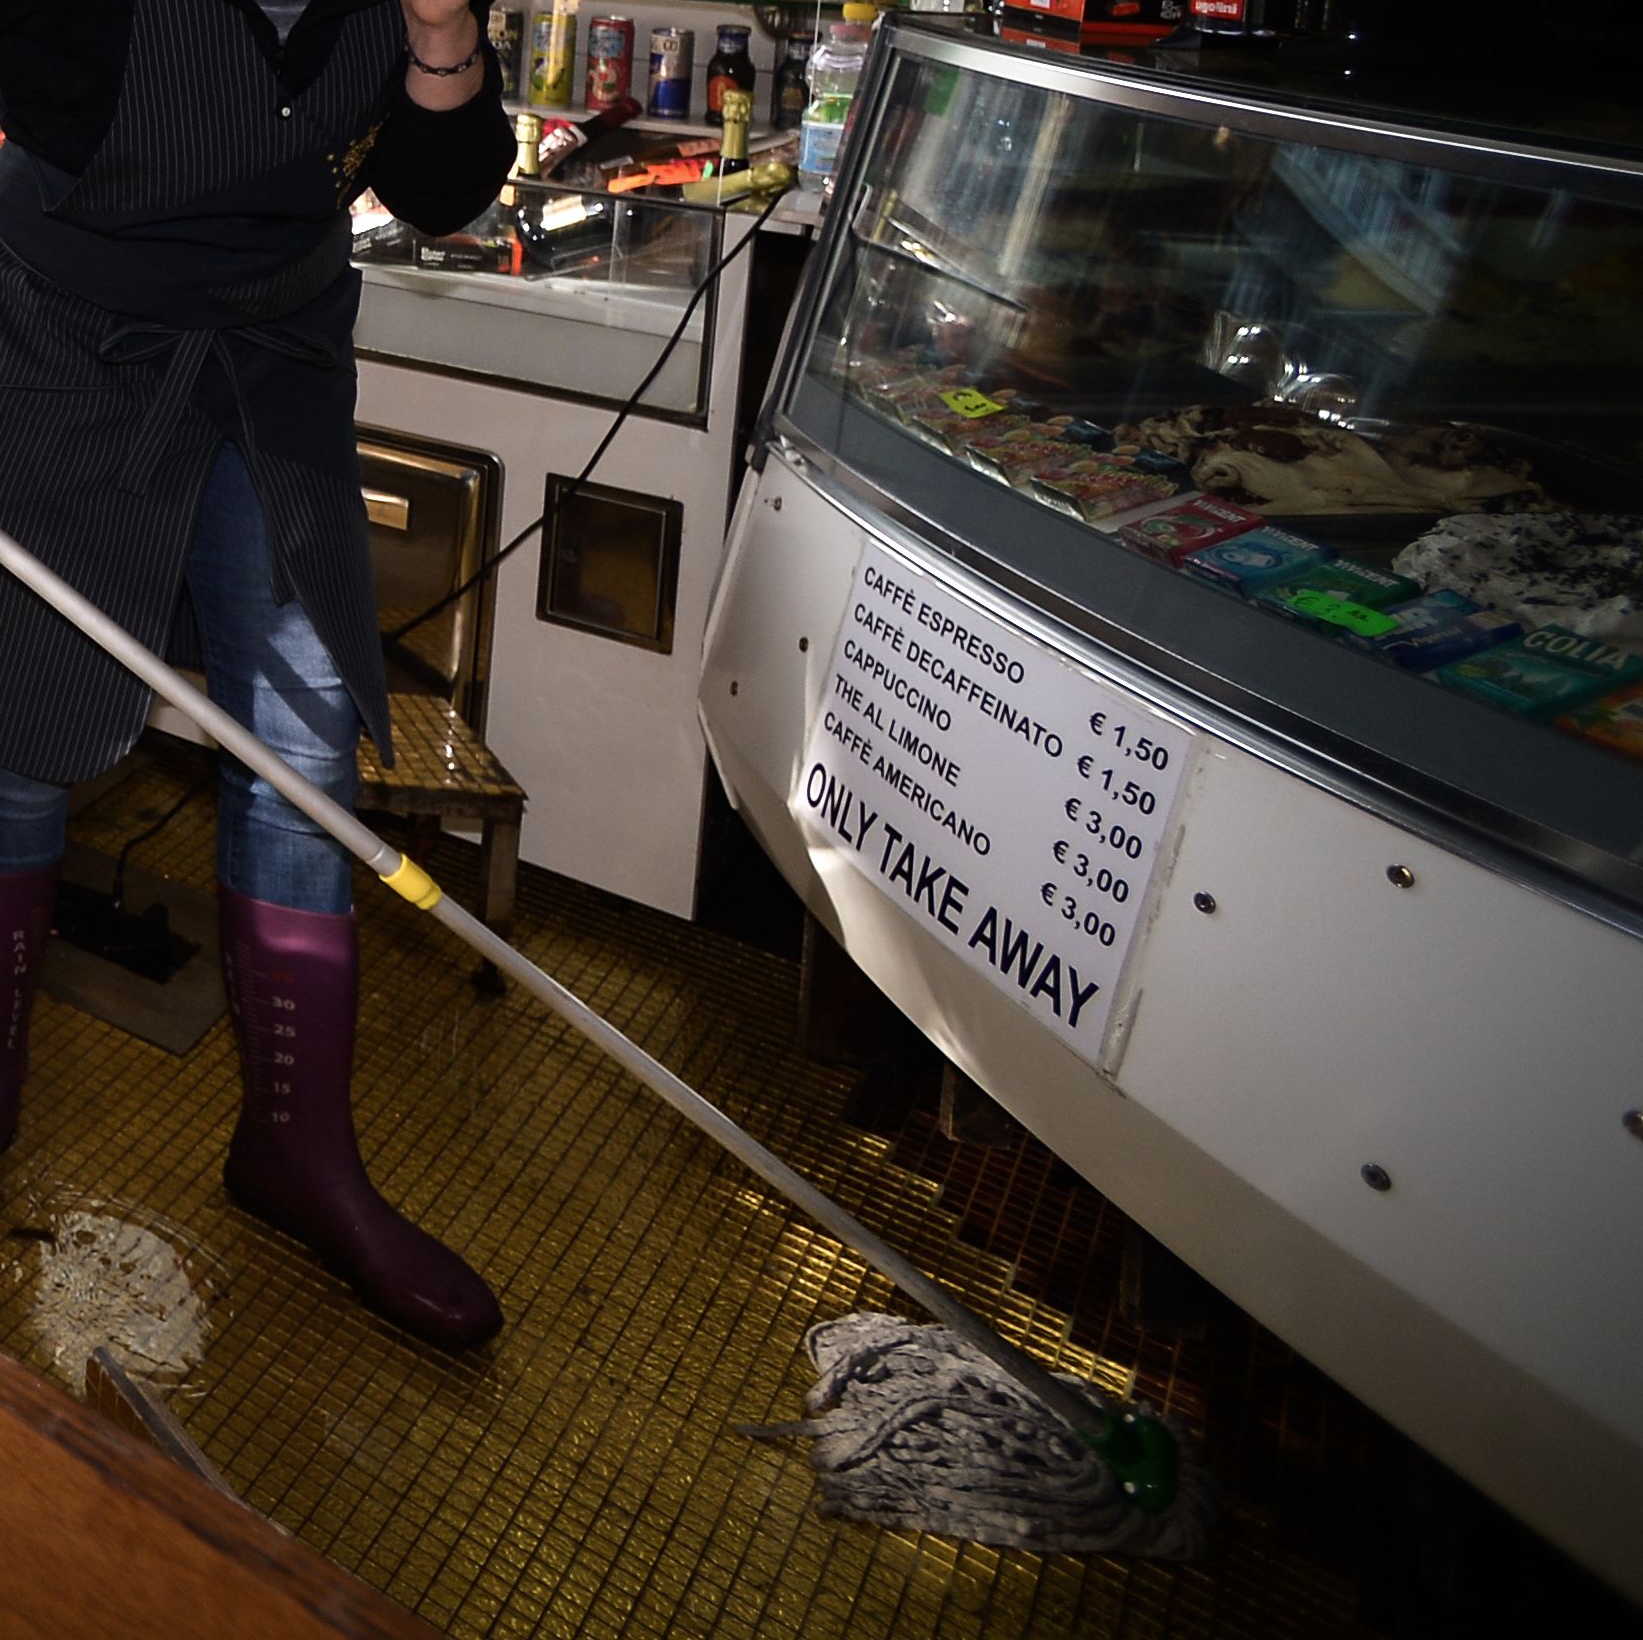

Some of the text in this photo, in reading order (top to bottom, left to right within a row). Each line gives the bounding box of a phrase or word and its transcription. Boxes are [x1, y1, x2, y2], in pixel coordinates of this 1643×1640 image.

[1195, 0, 1238, 16] ugolini
[843, 639, 952, 733] CAPPUCCINO
[1085, 810, 1143, 861] 3,00
[853, 602, 904, 655] CAFFÈ
[906, 641, 1064, 758] DECAFFEINATO
[1100, 769, 1157, 816] 1,50
[864, 566, 916, 617] CAFFÈ
[918, 603, 1026, 685] ESPRESSO
[1113, 725, 1170, 772] 1,50
[806, 762, 1100, 1029] ONLY TAKE AWAY
[823, 711, 873, 765] CAFFÈ
[872, 755, 992, 857] AMERICANO
[1061, 895, 1117, 948] 3,00
[835, 673, 862, 713] THE
[859, 701, 884, 733] AL
[888, 724, 961, 788] LIMONE
[1072, 853, 1130, 904] 3,00
